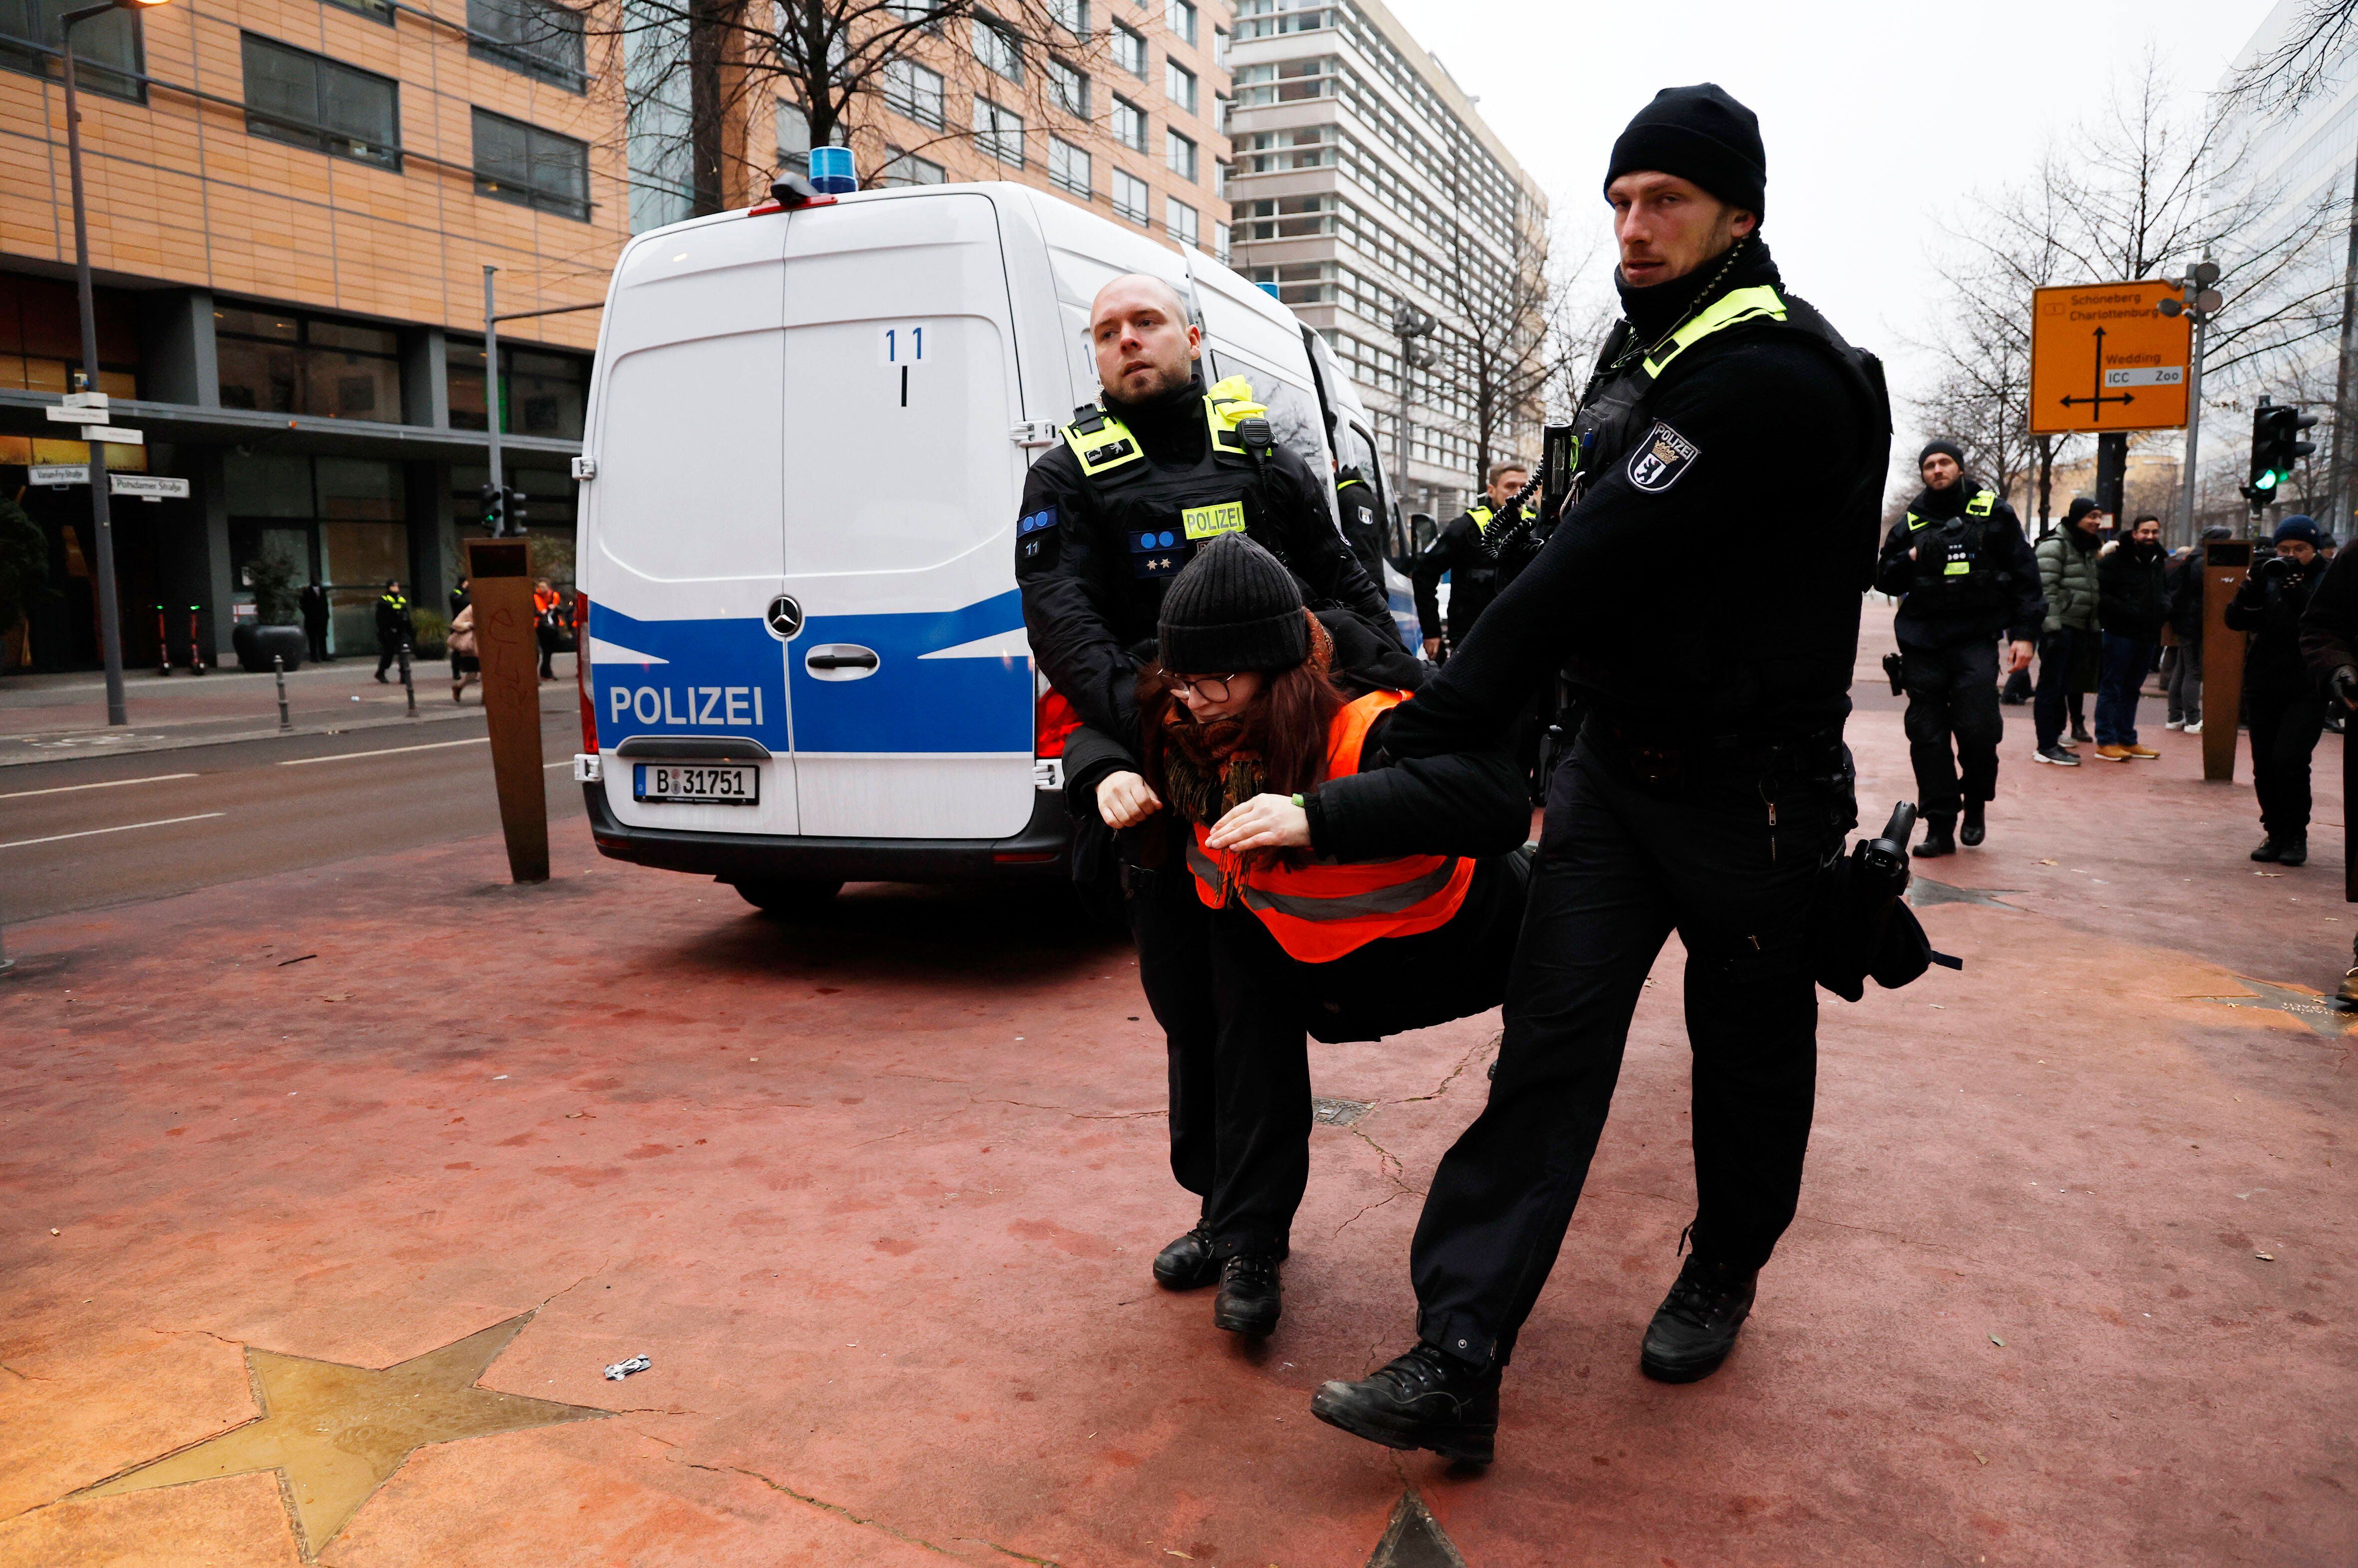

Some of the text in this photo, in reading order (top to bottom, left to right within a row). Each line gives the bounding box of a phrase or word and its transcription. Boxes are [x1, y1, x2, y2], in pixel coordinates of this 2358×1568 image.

[2071, 293, 2141, 305] Schöneberg
[2070, 308, 2159, 321] Charlottenburg
[2106, 353, 2161, 365] Wedding
[2109, 370, 2179, 383] ICC Zoo
[1655, 425, 1695, 460] POLIZEI
[1187, 507, 1241, 533] POLIZEI
[1026, 540, 1038, 555] 11
[610, 686, 763, 725] POLIZEI
[657, 770, 744, 794] B 31751
